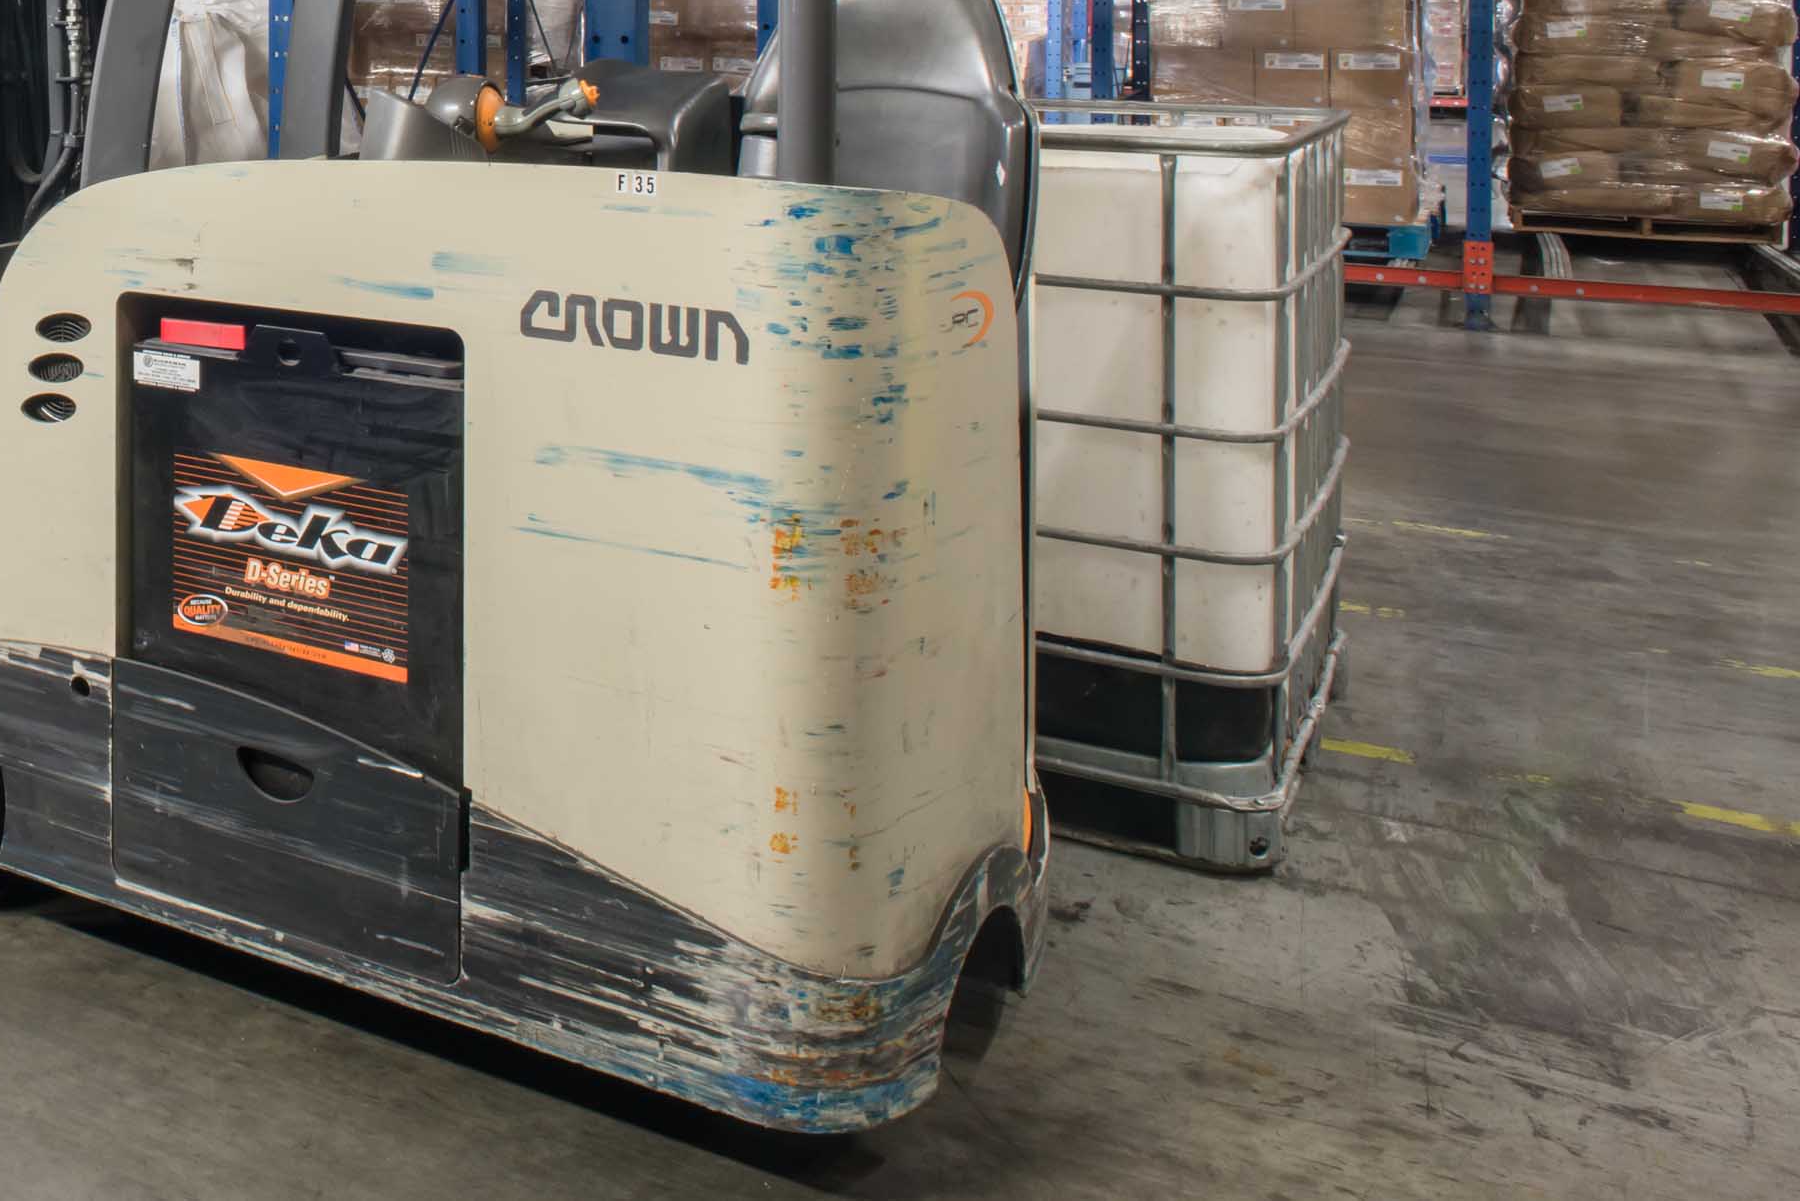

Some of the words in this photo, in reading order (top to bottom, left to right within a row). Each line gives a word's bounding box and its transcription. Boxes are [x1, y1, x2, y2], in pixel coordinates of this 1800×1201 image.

[618, 174, 626, 191] F
[635, 176, 655, 194] 35
[520, 289, 750, 365] CROWN
[182, 491, 398, 567] Deka
[184, 605, 222, 617] QUALITY
[224, 586, 267, 605] Durability
[268, 597, 286, 608] and
[287, 600, 351, 623] dependability.
